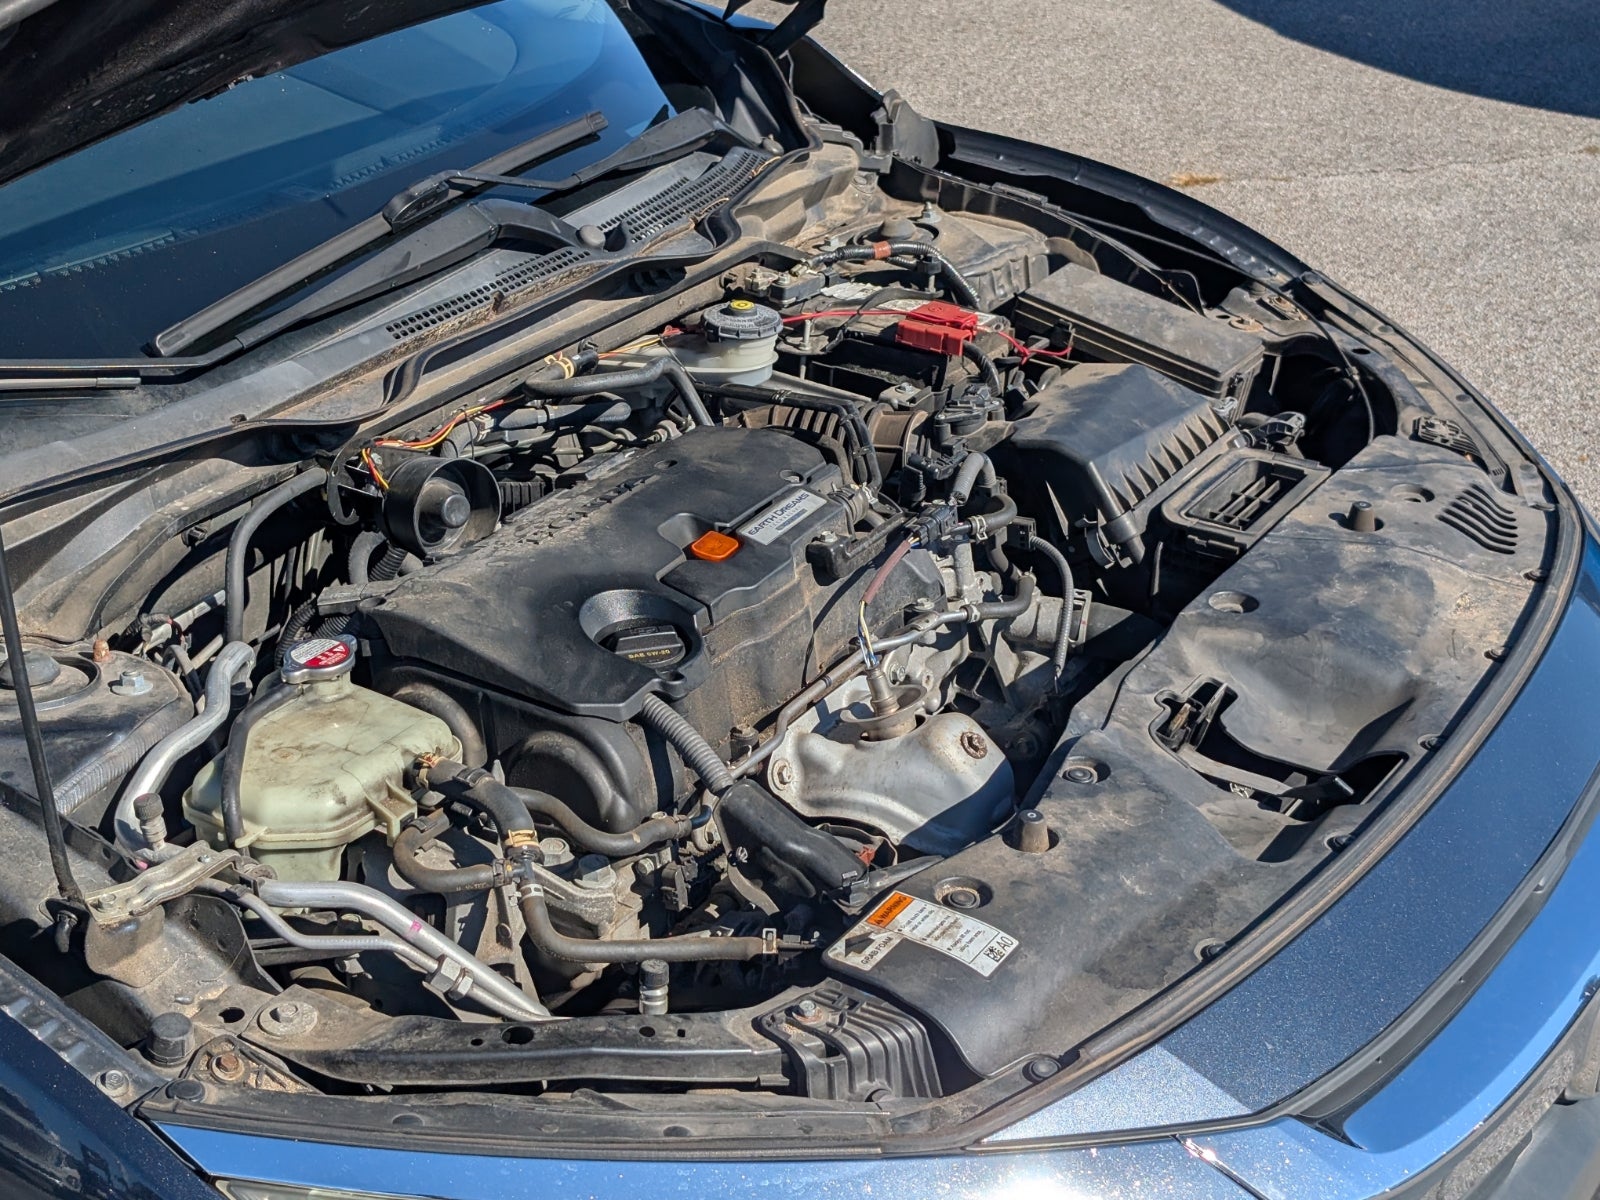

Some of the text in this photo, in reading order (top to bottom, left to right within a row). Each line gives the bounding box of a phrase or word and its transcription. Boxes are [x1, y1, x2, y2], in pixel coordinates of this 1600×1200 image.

[747, 514, 777, 536] EARTH
[774, 493, 810, 516] DREAMS
[880, 895, 907, 919] WARNING
[861, 936, 894, 965] GRAB FOAM
